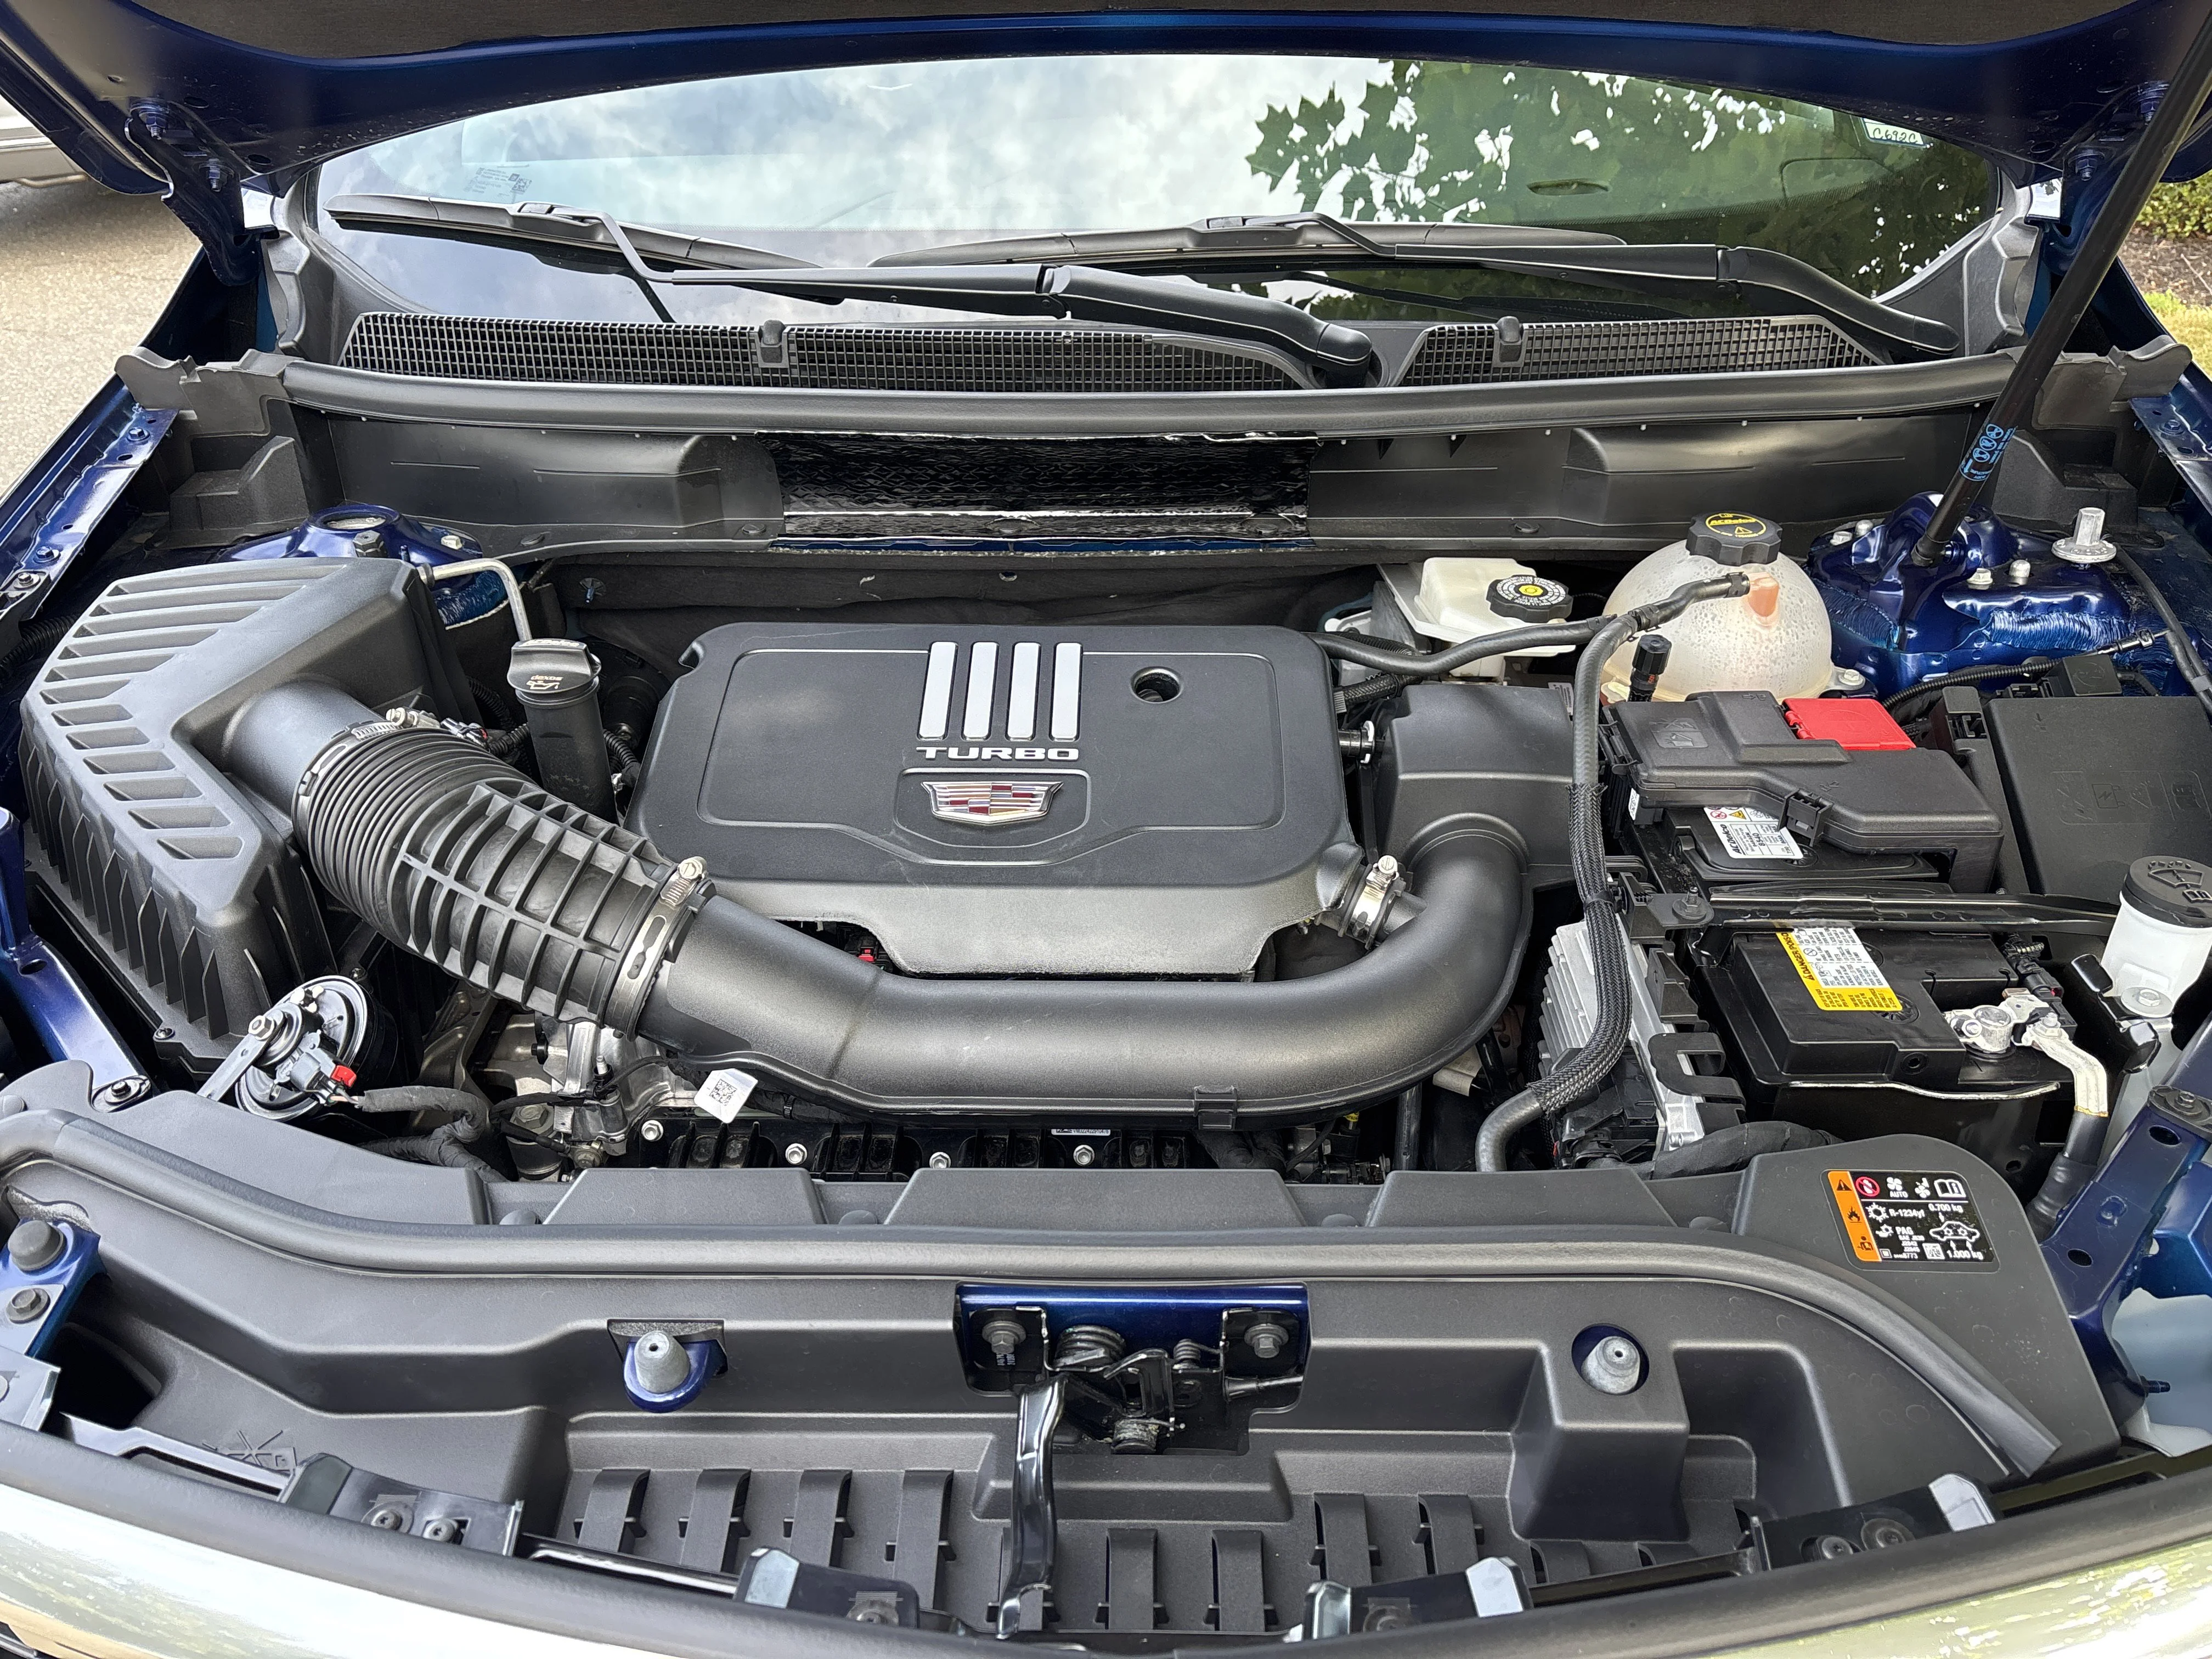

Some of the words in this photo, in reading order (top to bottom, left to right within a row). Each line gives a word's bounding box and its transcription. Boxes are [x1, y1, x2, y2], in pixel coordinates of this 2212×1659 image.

[916, 747, 1079, 761] TURBO
[1720, 823, 1742, 855] ACDelco
[1752, 832, 1766, 847] 8540
[1781, 932, 1811, 976] DANGER/POISO
[1928, 1203, 1951, 1211] 0.700
[1951, 1204, 1963, 1213] kg
[1895, 1226, 1914, 1235] PAG
[1946, 1250, 1971, 1258] 1.000
[1971, 1250, 1984, 1260] kg
